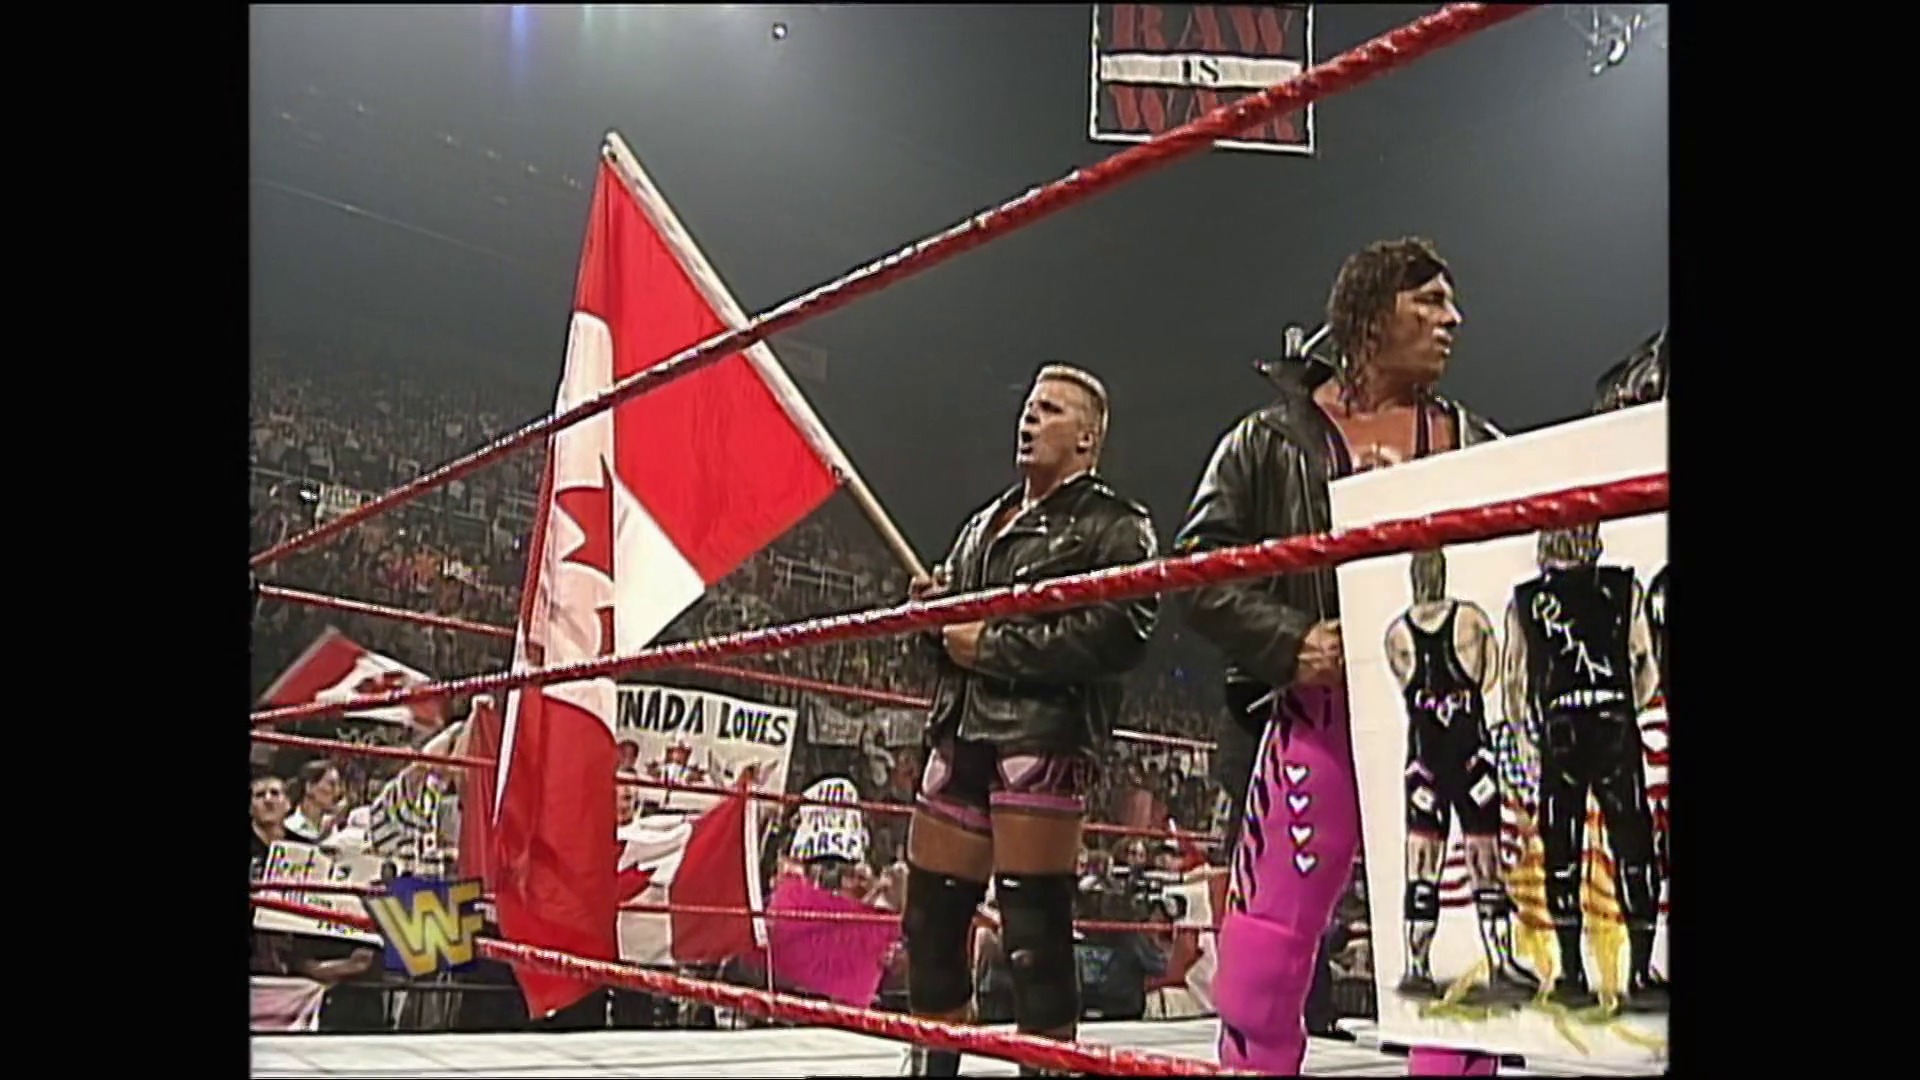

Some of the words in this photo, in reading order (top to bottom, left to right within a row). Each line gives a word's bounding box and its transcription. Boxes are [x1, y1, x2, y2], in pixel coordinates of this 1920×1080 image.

[1111, 4, 1294, 54] RAW
[1182, 59, 1219, 84] IS
[617, 689, 704, 735] NADA
[717, 702, 789, 746] LOVES
